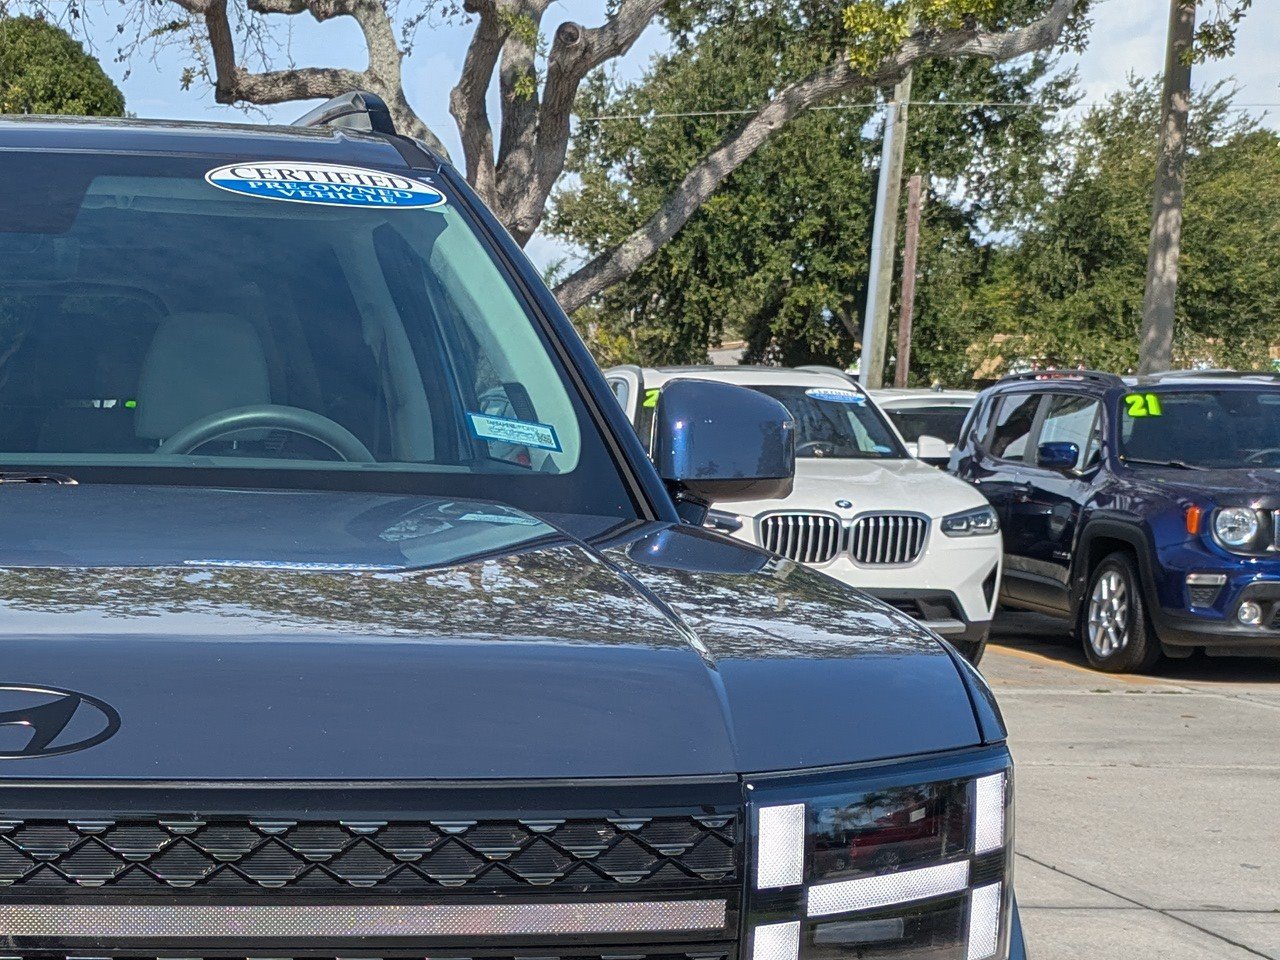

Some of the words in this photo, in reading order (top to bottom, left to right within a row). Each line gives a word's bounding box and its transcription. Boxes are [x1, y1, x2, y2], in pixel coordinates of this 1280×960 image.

[230, 168, 413, 190] CERTIFIED
[248, 181, 414, 199] PRE-OWNED
[277, 189, 398, 204] VEHICLE
[1125, 394, 1161, 416] 21
